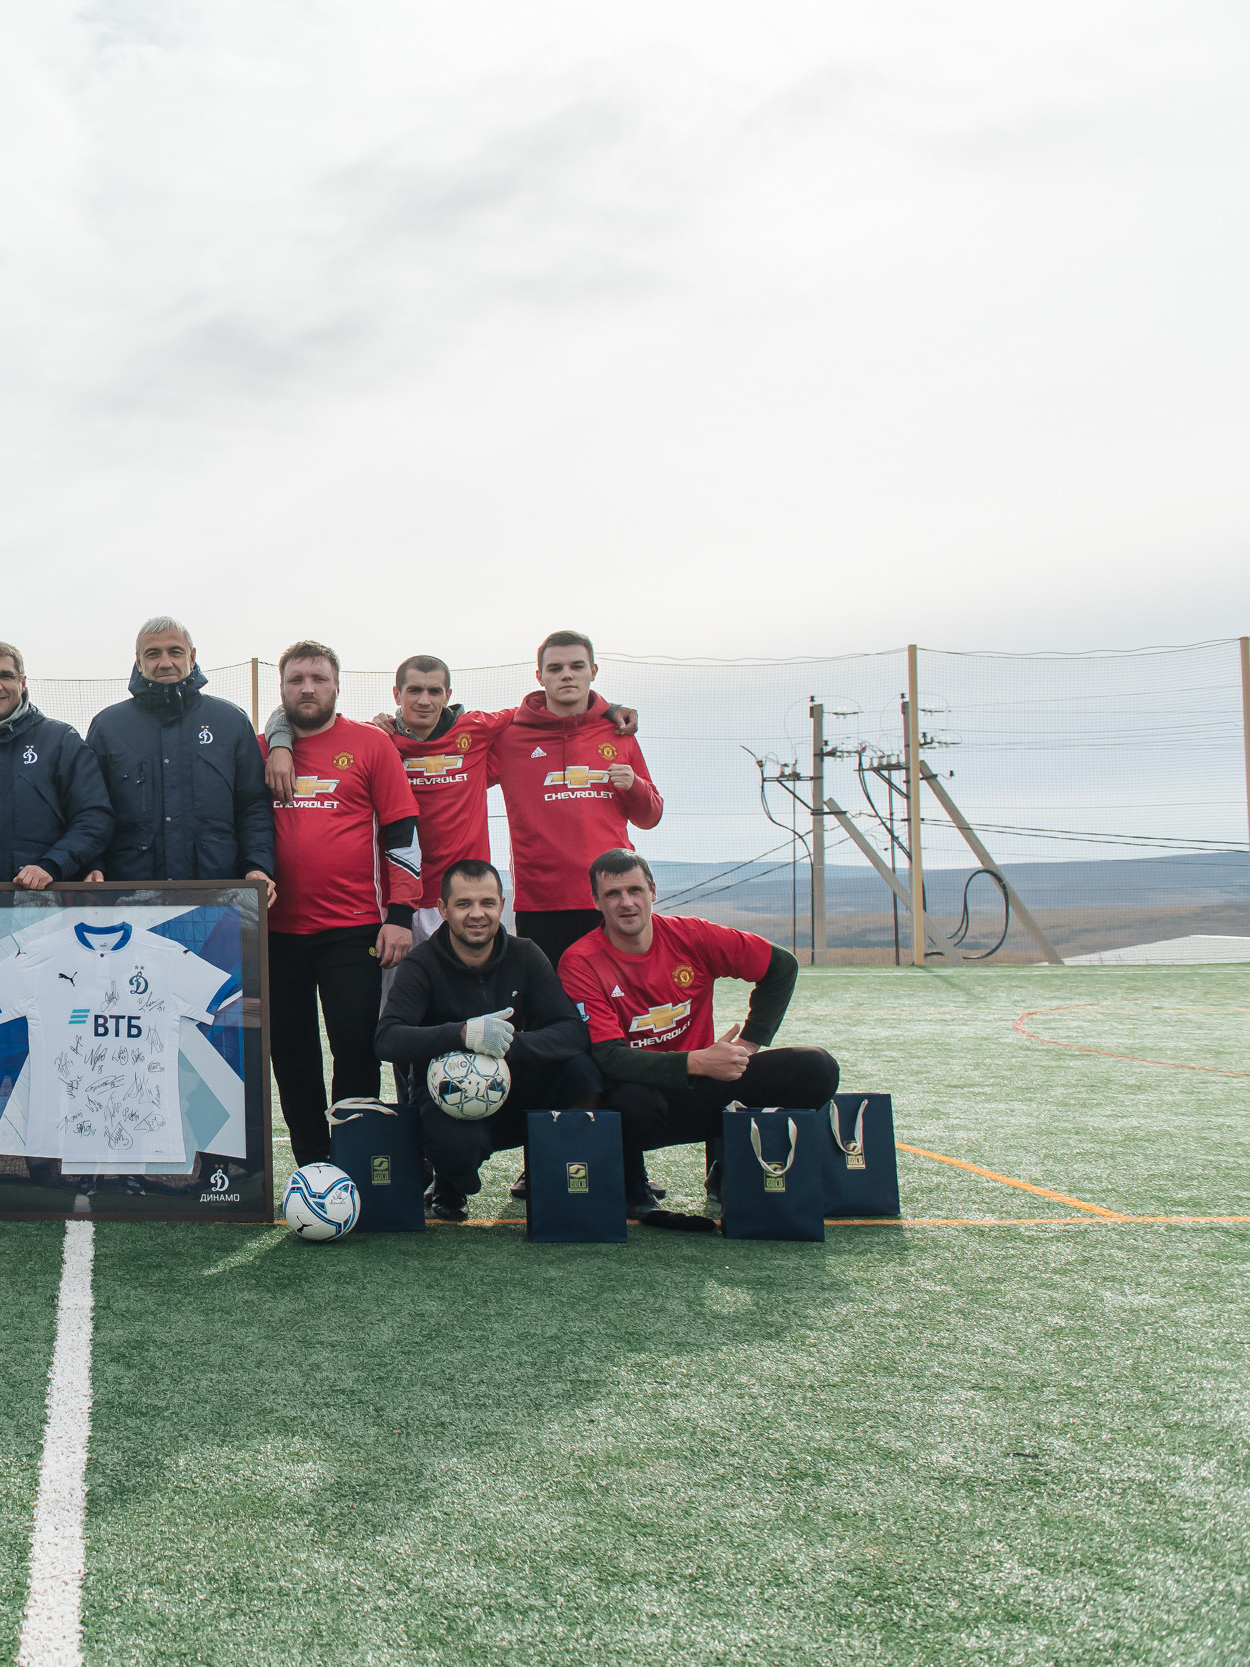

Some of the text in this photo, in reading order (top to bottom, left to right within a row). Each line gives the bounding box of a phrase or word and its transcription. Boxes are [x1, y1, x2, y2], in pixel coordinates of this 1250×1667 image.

[408, 773, 468, 785] HEVROLET
[544, 790, 614, 801] CHEVROLET
[93, 1014, 143, 1039] ВТБ
[200, 1193, 240, 1202] ДИНАМО
